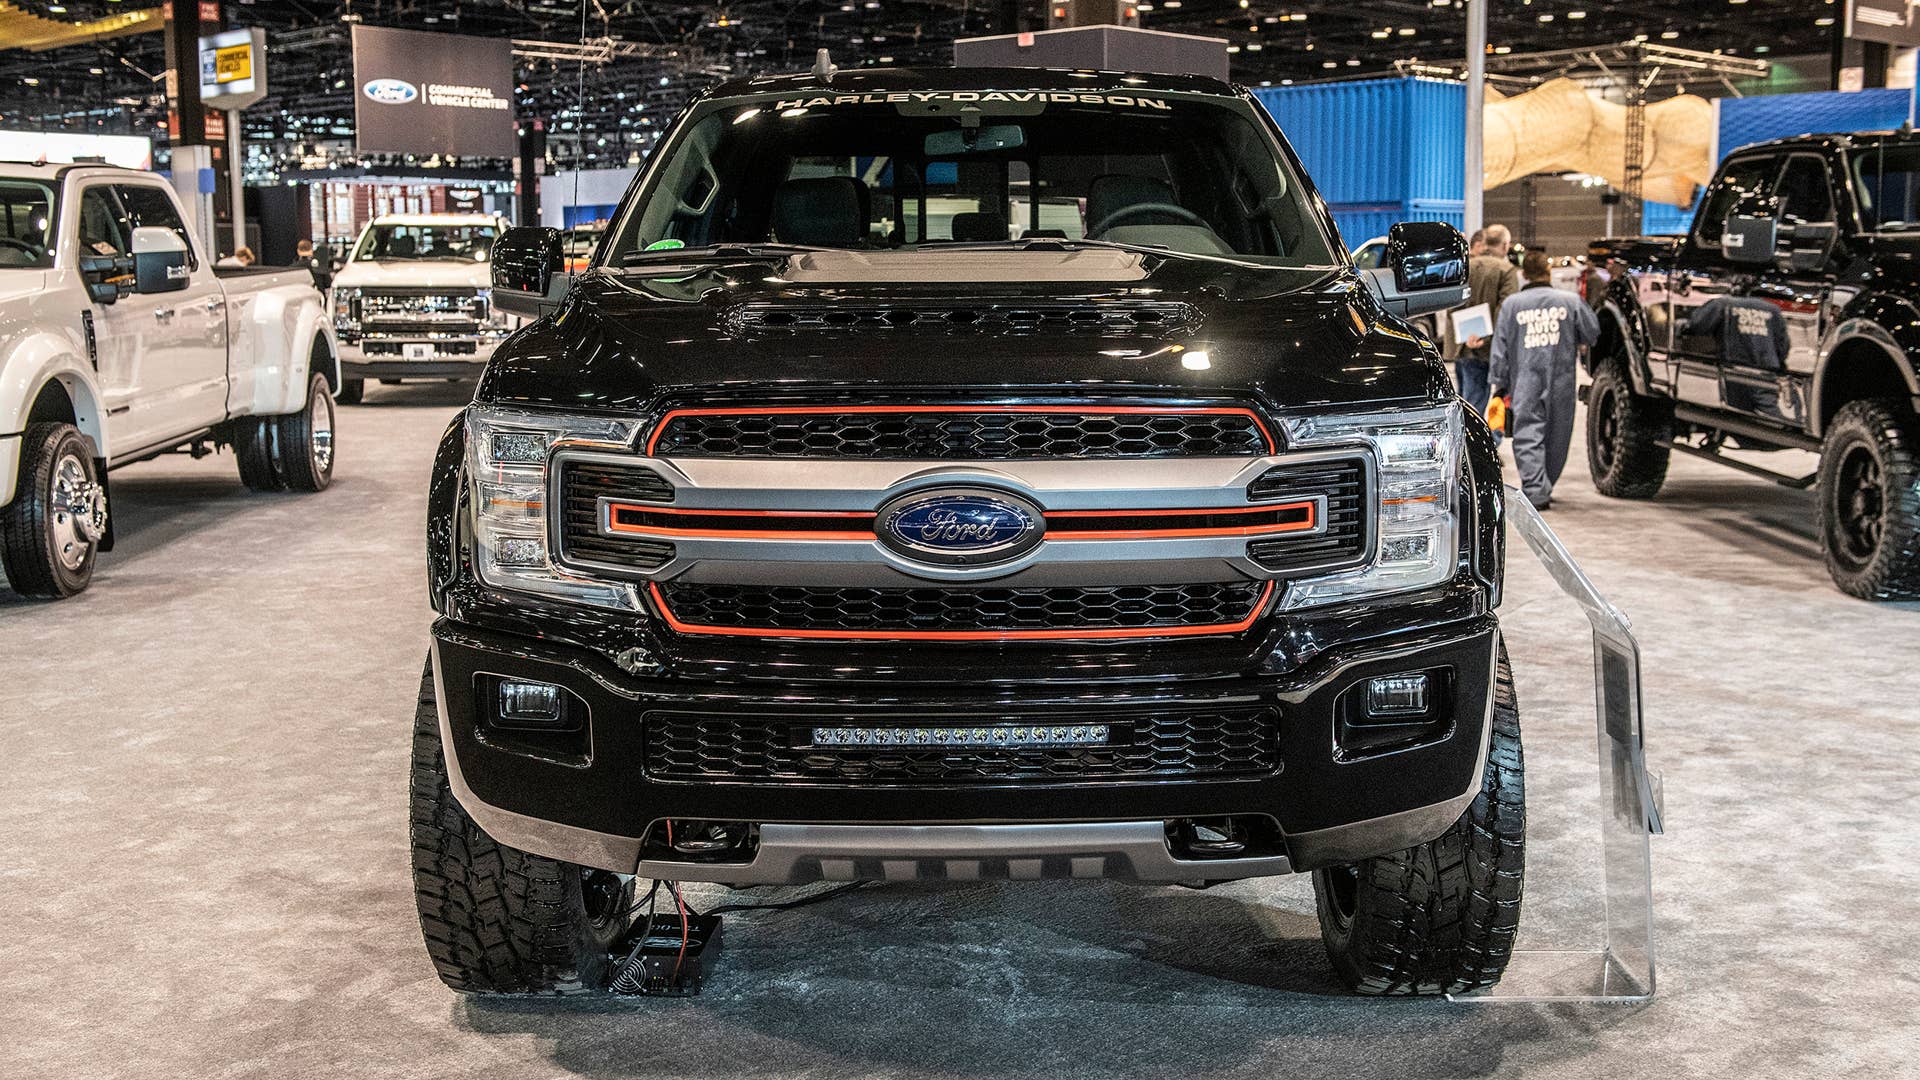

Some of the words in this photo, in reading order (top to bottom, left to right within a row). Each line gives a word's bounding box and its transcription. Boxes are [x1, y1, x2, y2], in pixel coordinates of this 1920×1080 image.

[428, 84, 494, 98] COMMERCIAL
[429, 95, 470, 107] VEHICLE
[470, 98, 509, 110] CENTER
[1516, 306, 1567, 325] CHICAGO
[1526, 320, 1560, 335] AUTO
[1524, 332, 1560, 349] SHOW
[921, 508, 998, 541] Ford
